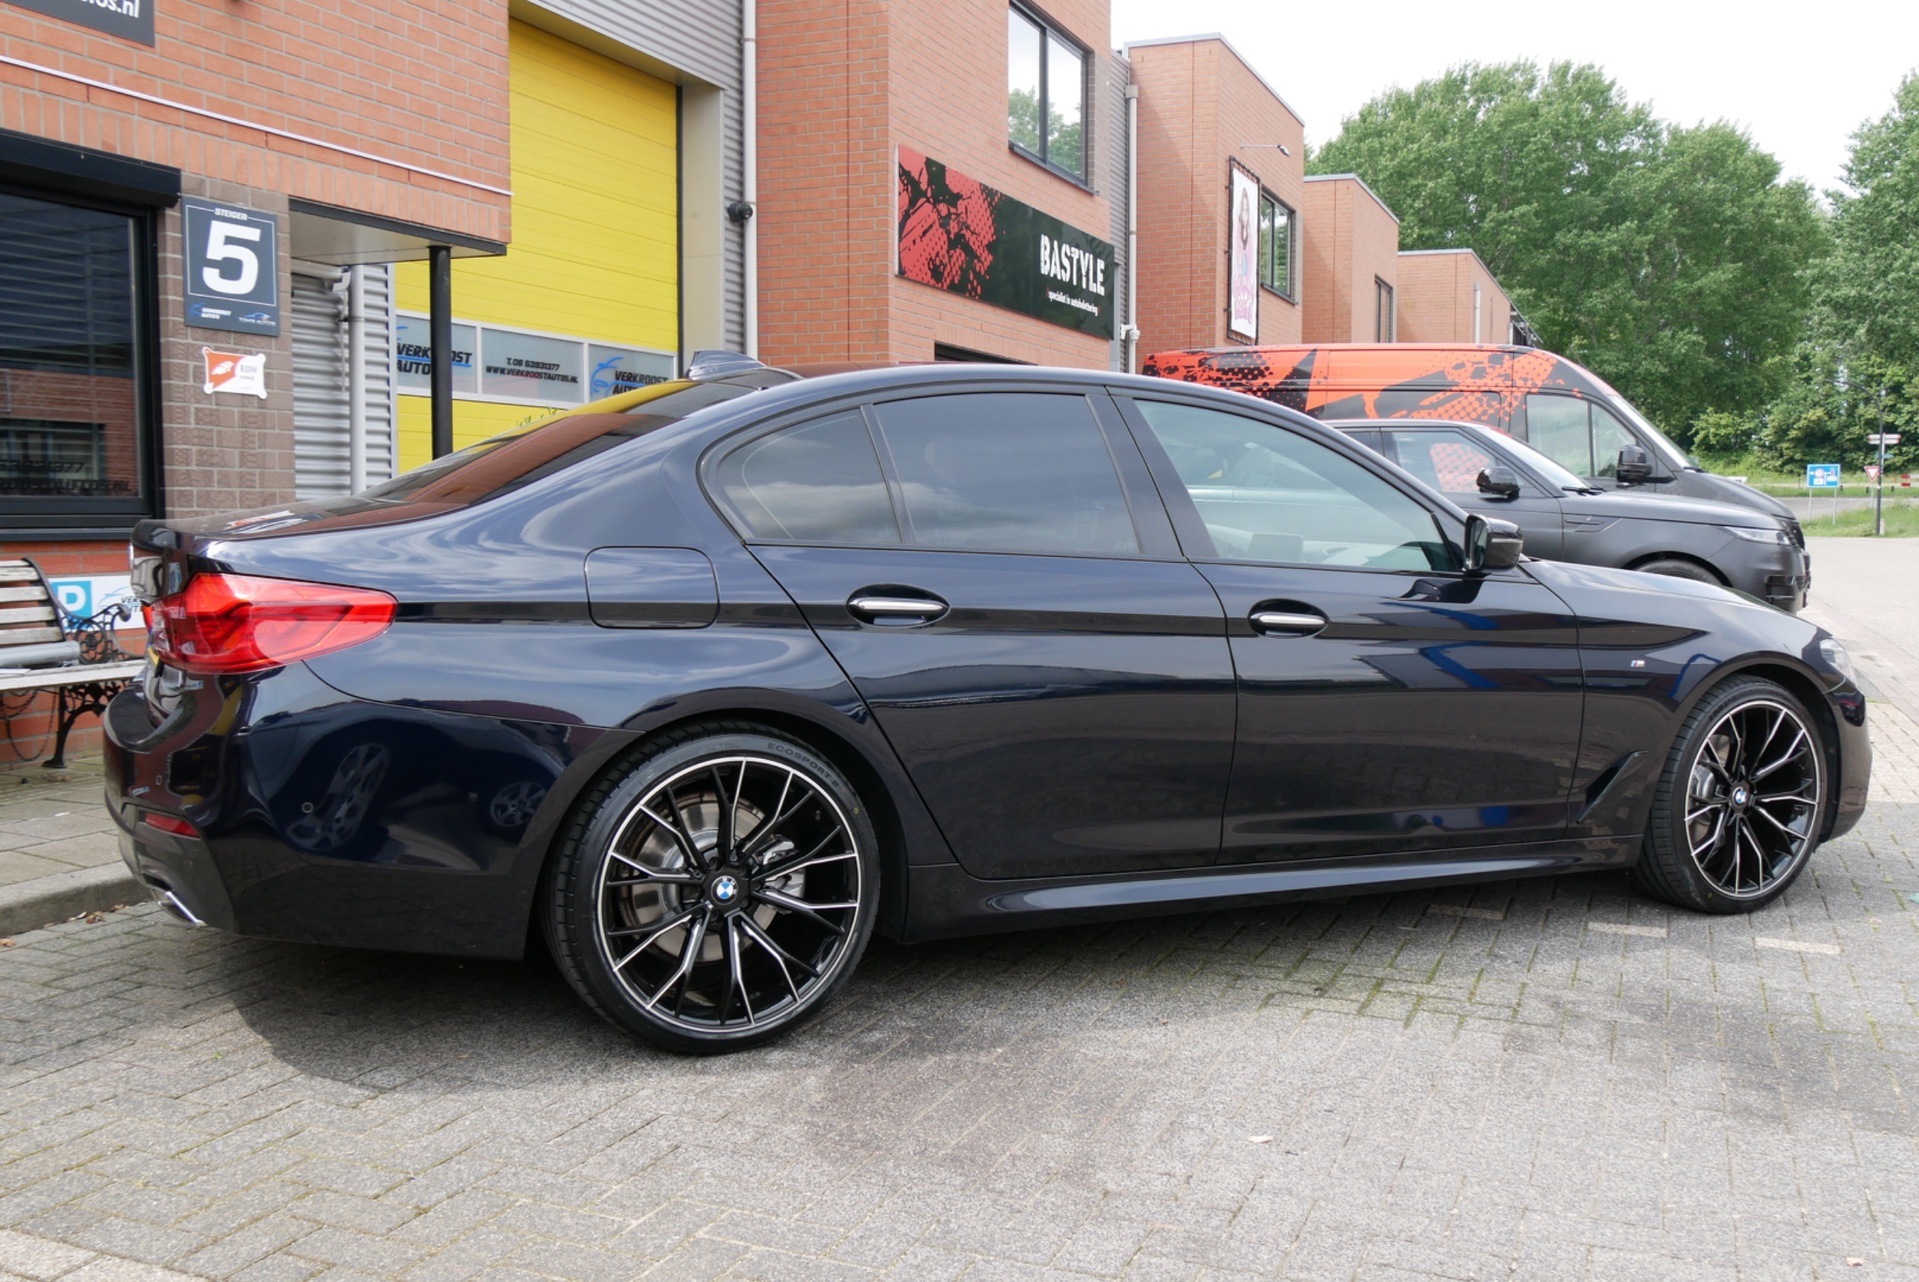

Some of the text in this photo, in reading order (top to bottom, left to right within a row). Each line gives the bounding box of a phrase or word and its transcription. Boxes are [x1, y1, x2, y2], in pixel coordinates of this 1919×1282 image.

[214, 207, 248, 221] STEIGER
[202, 220, 261, 295] 5
[1041, 233, 1105, 297] BASTYLE
[513, 358, 524, 368] 06
[486, 365, 579, 384] WWW.VERKROOSTAUTOS.NL
[615, 370, 669, 385] VERKROOST
[767, 742, 831, 779] ECOSPORT
